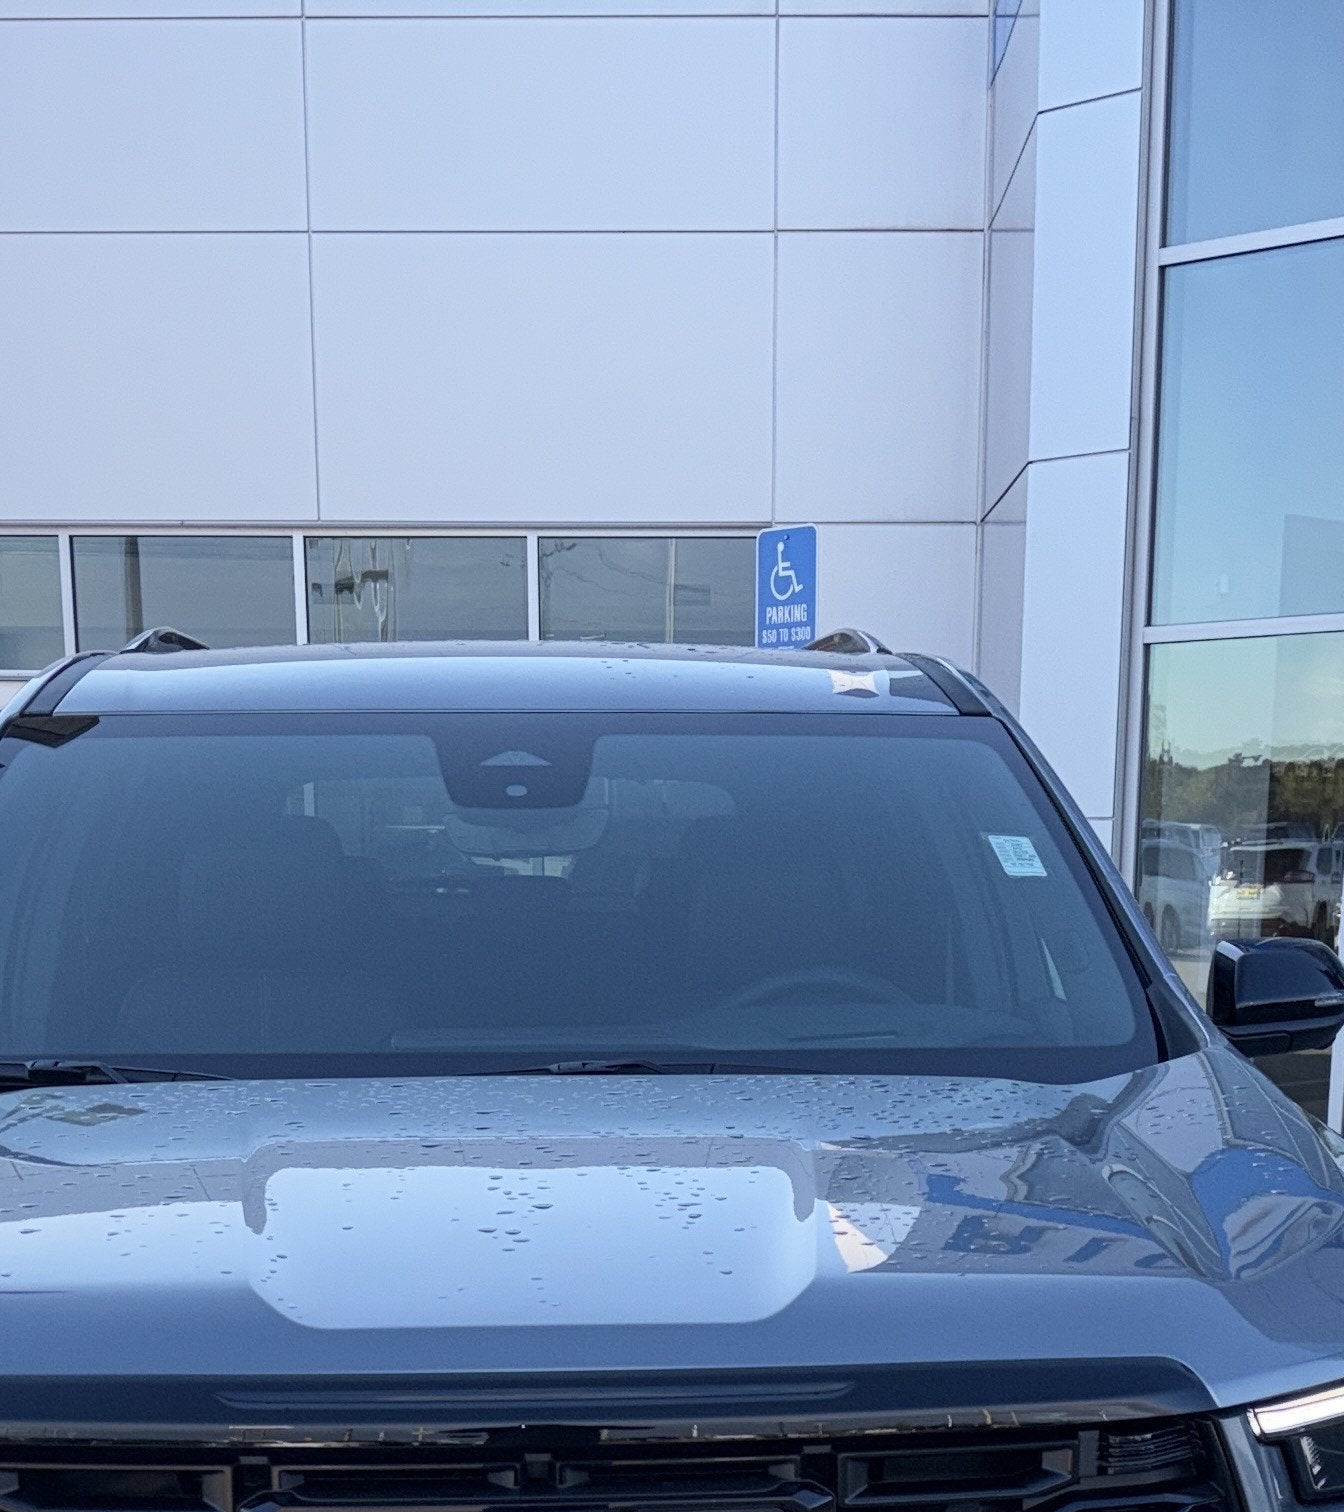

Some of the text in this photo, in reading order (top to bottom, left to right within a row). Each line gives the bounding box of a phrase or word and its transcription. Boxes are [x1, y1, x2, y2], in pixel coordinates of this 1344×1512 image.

[766, 604, 807, 625] PARKING
[762, 626, 811, 644] $50 TO $300
